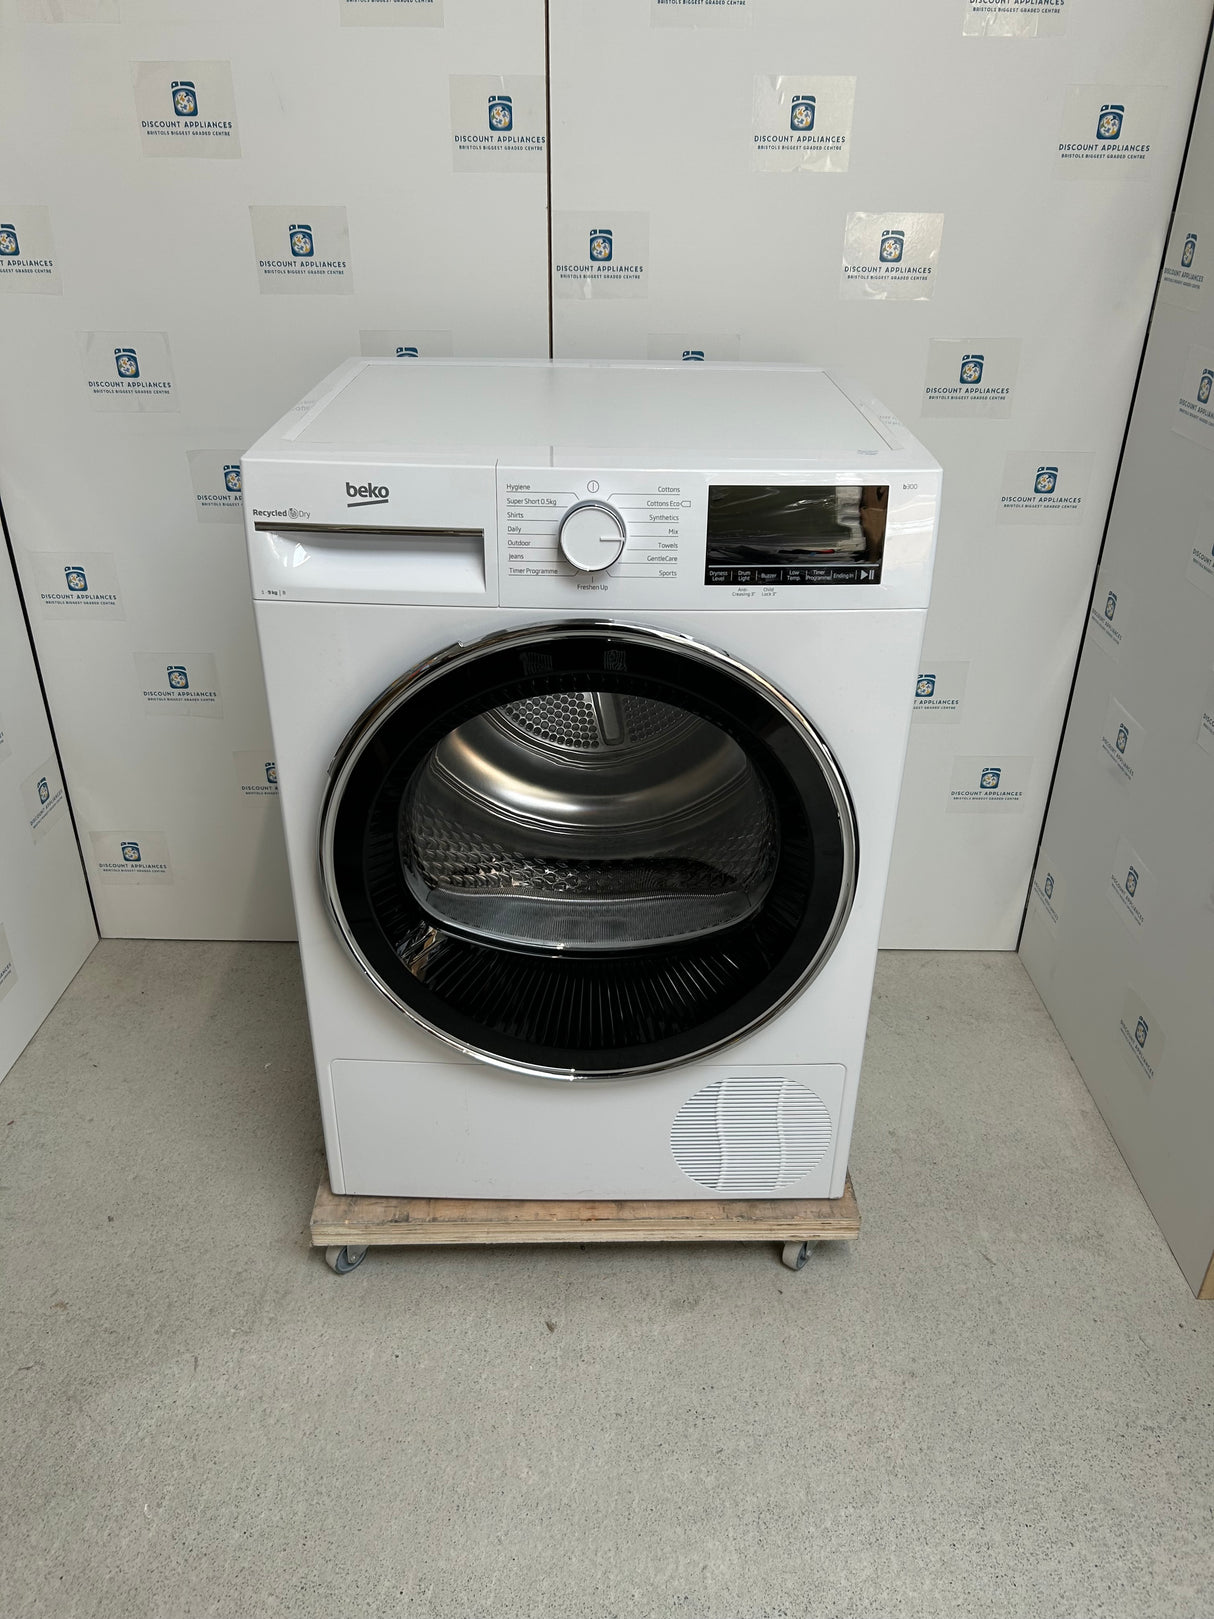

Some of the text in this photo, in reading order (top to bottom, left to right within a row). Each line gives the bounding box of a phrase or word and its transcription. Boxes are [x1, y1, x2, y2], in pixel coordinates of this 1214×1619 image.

[346, 482, 389, 499] beko
[253, 509, 310, 519] Recycled Dry
